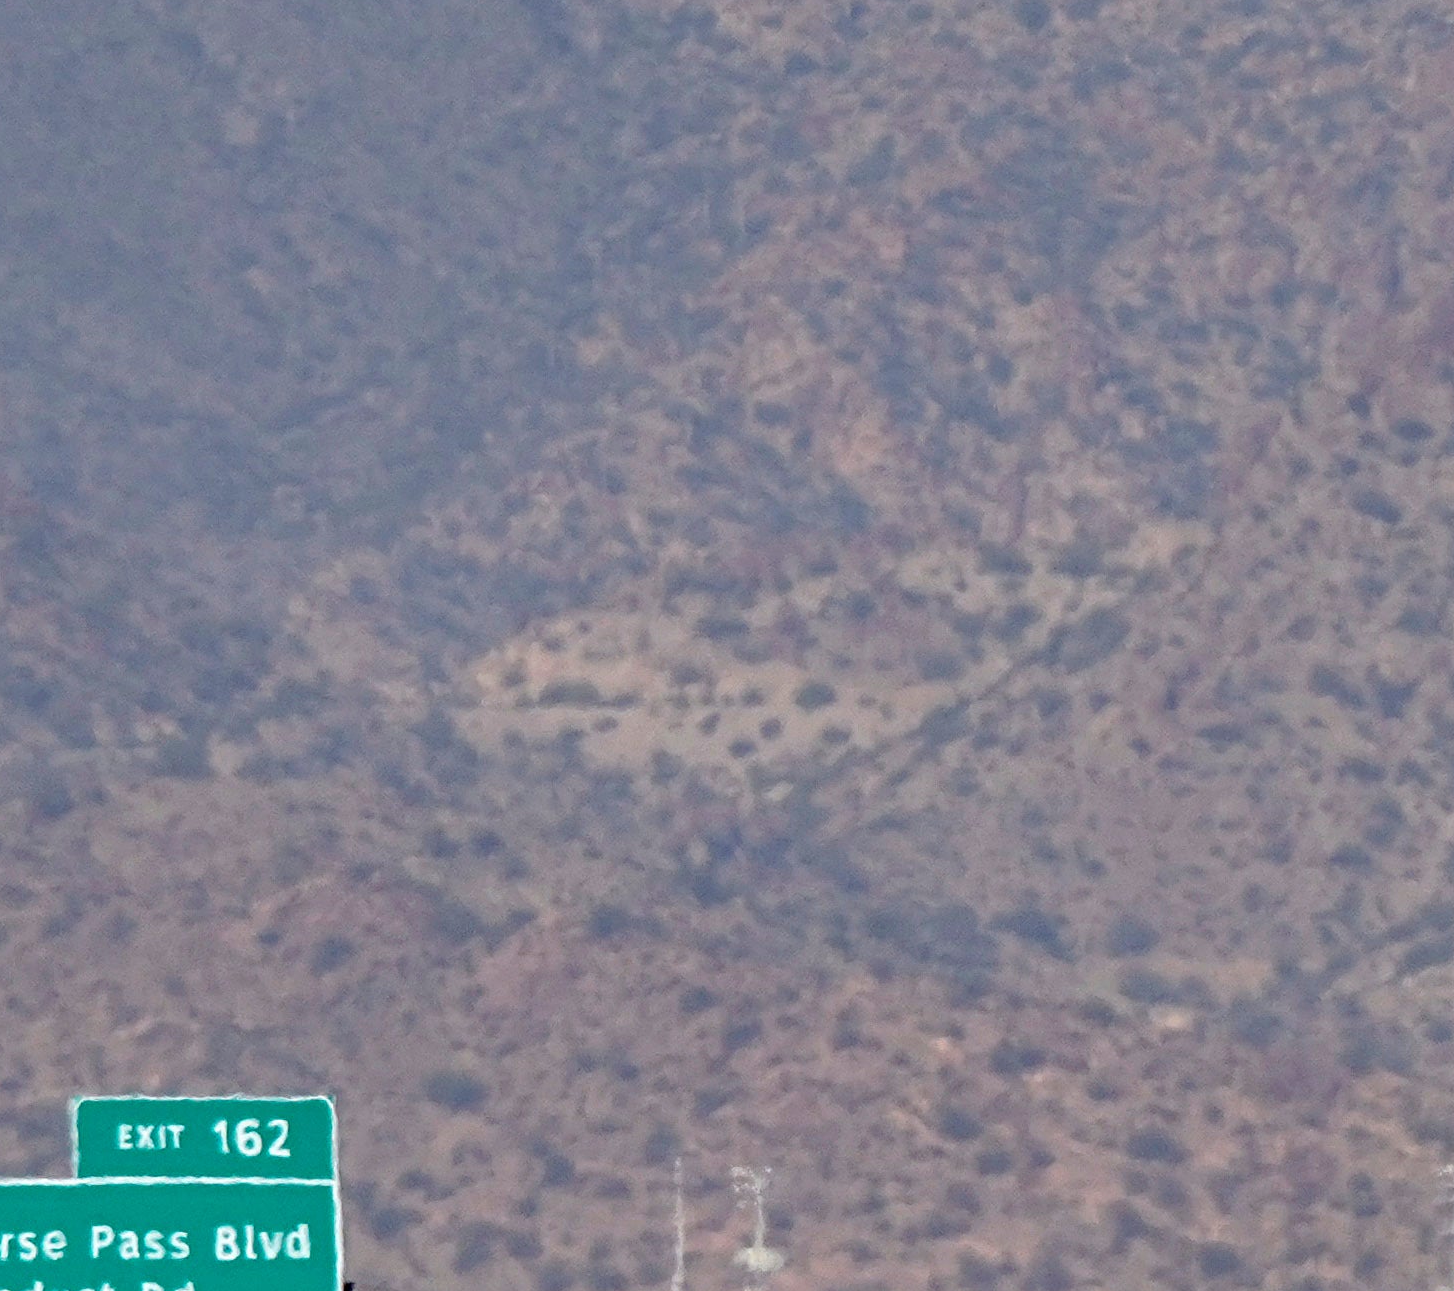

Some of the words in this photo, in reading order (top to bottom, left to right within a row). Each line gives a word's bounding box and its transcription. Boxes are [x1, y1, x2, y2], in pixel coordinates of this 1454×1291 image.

[117, 1124, 185, 1150] EXIT
[212, 1118, 291, 1158] 162
[90, 1225, 191, 1260] Pass
[214, 1223, 311, 1261] Blvd
